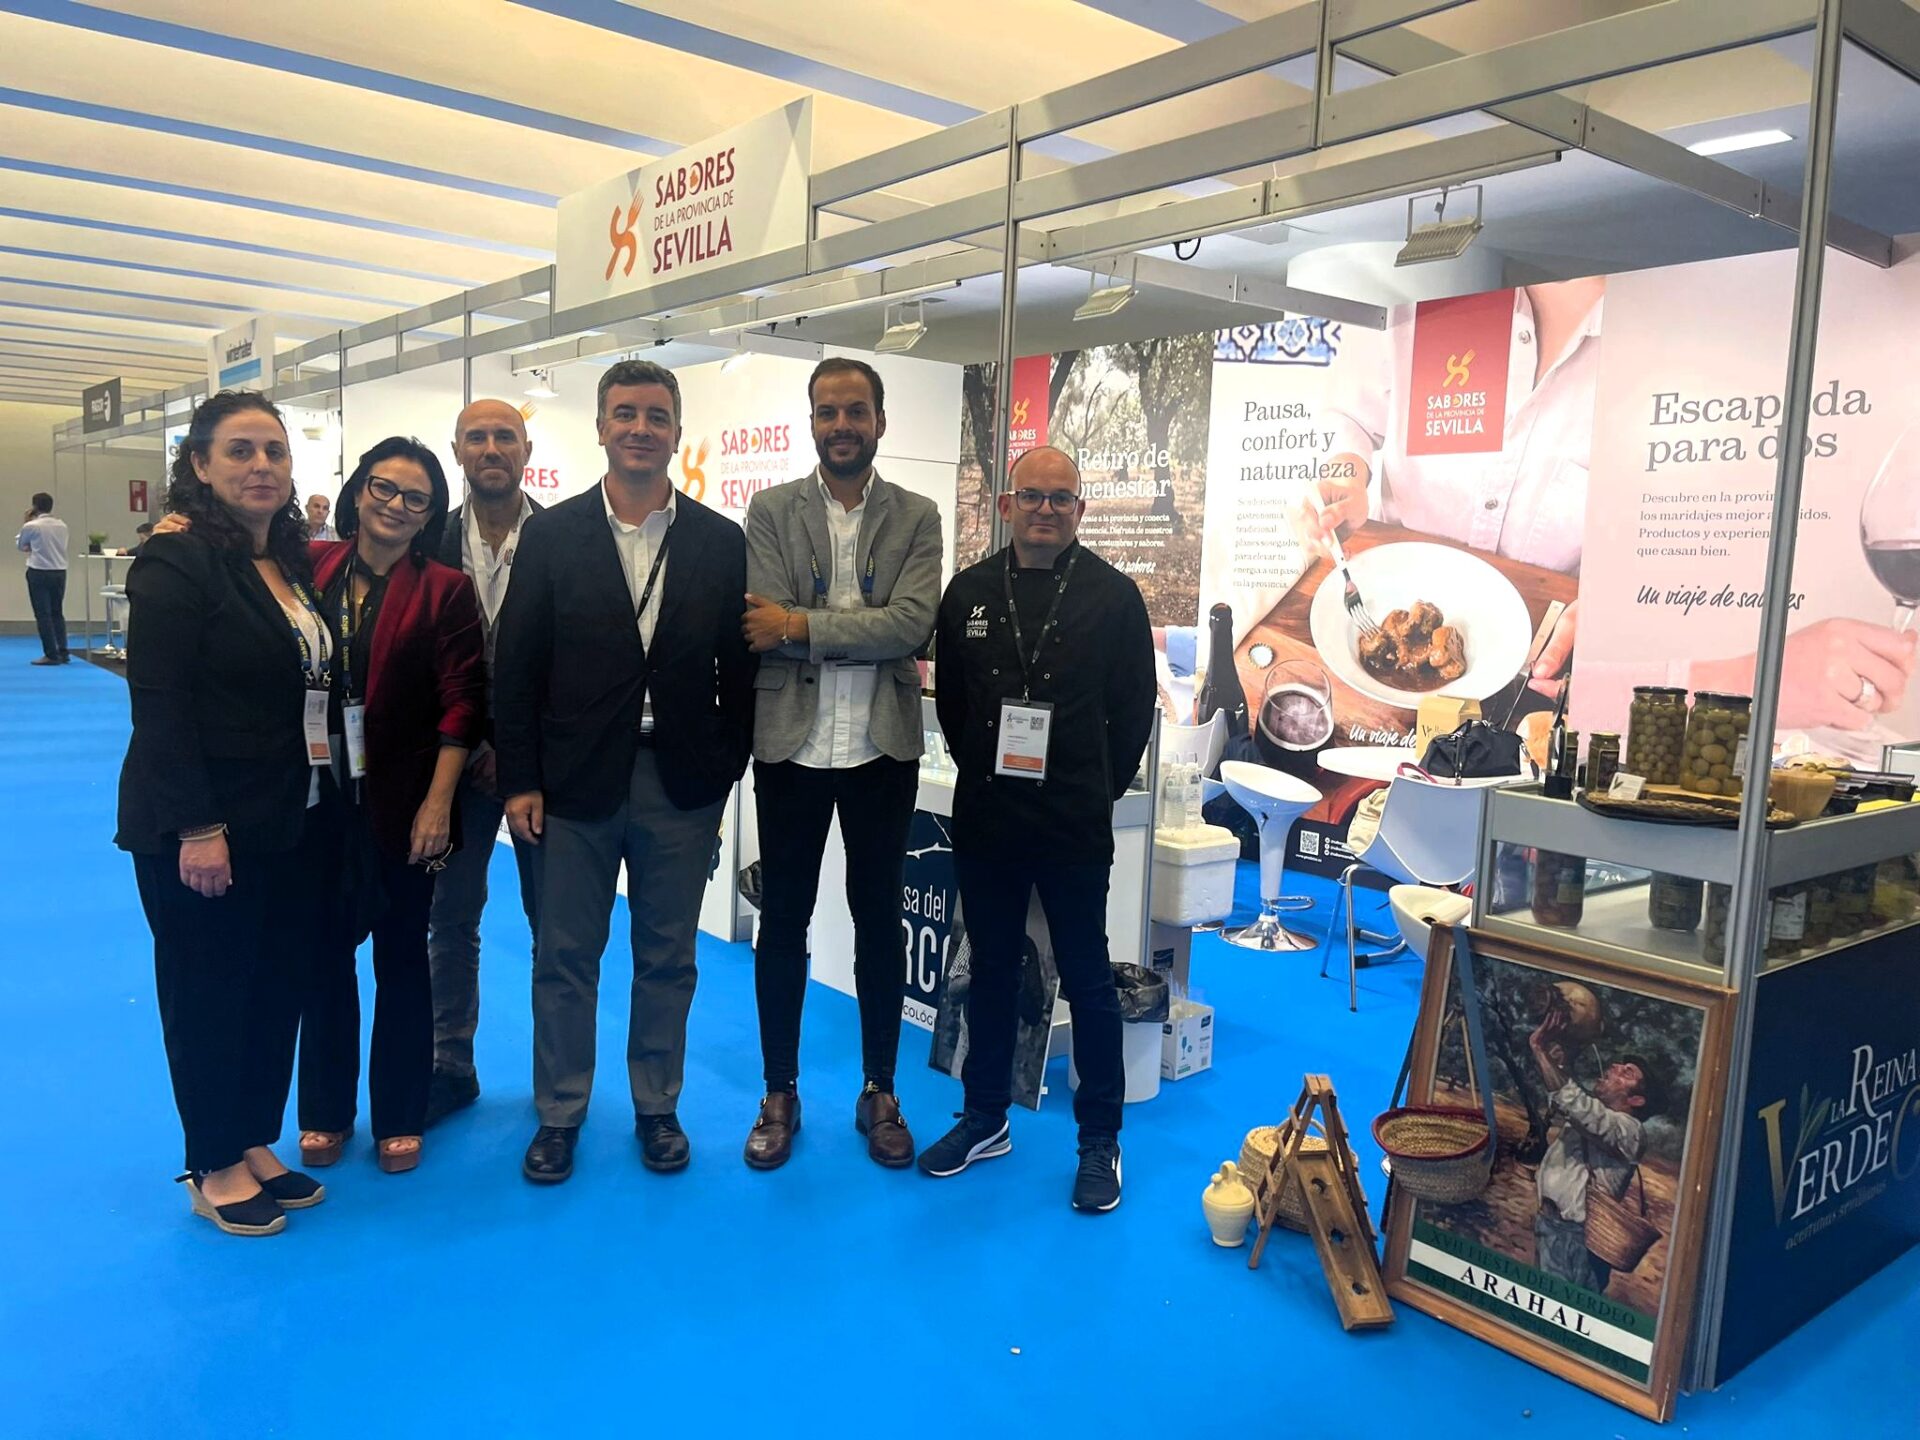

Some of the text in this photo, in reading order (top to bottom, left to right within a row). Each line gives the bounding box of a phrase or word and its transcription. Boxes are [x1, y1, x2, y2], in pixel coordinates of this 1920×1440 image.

[655, 147, 735, 208] SABORES
[654, 190, 734, 231] DE LA PROVINCIA DE
[653, 215, 732, 274] SEVILLA
[1244, 401, 1311, 421] Pausa,
[1427, 392, 1486, 410] SABORES
[1650, 380, 1872, 428] Escapda
[1427, 411, 1434, 419] DE
[1444, 409, 1475, 418] PROVINCIA
[1477, 408, 1484, 416] DE
[1425, 418, 1484, 436] SEVILLA
[721, 425, 789, 456] SABORES
[1242, 428, 1336, 452] confort y
[1078, 442, 1169, 471] Retiro de
[1645, 436, 1746, 472] para
[523, 467, 559, 489] RES
[1240, 457, 1358, 481] naturaleza
[1642, 490, 1776, 504] Descubre en la provi
[1110, 513, 1138, 523] provincia
[1640, 510, 1657, 521] los
[1660, 510, 1723, 522] maridajes
[1725, 509, 1765, 522] mejor
[1638, 528, 1771, 541] Productos y experien
[1636, 545, 1731, 557] que casan bien.
[1637, 583, 1805, 616] Un viaje de saes
[1349, 724, 1366, 741] Un
[1370, 725, 1400, 748] viaje
[903, 884, 947, 924] sa del
[1831, 1044, 1918, 1124] LA REINA
[1460, 1266, 1591, 1337] ARAHAL
[1564, 1285, 1636, 1327] VERDEO
